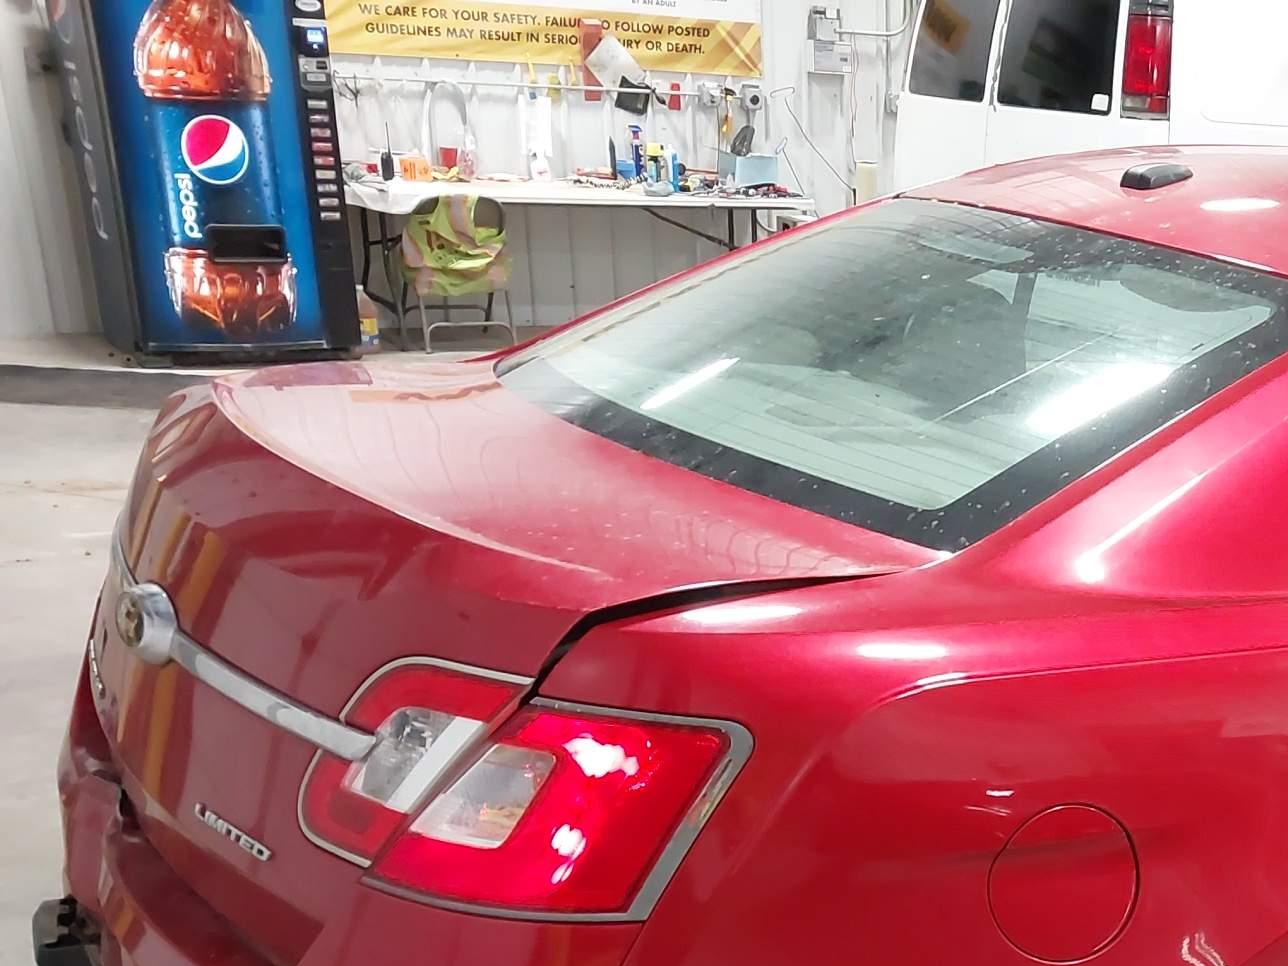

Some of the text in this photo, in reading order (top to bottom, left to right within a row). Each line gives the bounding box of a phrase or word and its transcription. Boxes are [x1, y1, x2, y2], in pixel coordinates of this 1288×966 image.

[358, 3, 381, 16] WE
[384, 4, 417, 17] CARE
[422, 7, 448, 20] FOR
[452, 8, 489, 22] YOUR
[493, 12, 540, 26] SAFETY.
[614, 21, 663, 35] FOLLOW
[667, 25, 710, 38] POSTED
[365, 22, 441, 37] GUIDELINES
[446, 28, 474, 39] MAY
[480, 29, 522, 42] RESULT
[526, 32, 540, 43] IN
[645, 40, 663, 52] OR
[667, 42, 705, 55] DEATH.
[173, 172, 203, 238] pepsi
[194, 801, 272, 861] LIMITED
